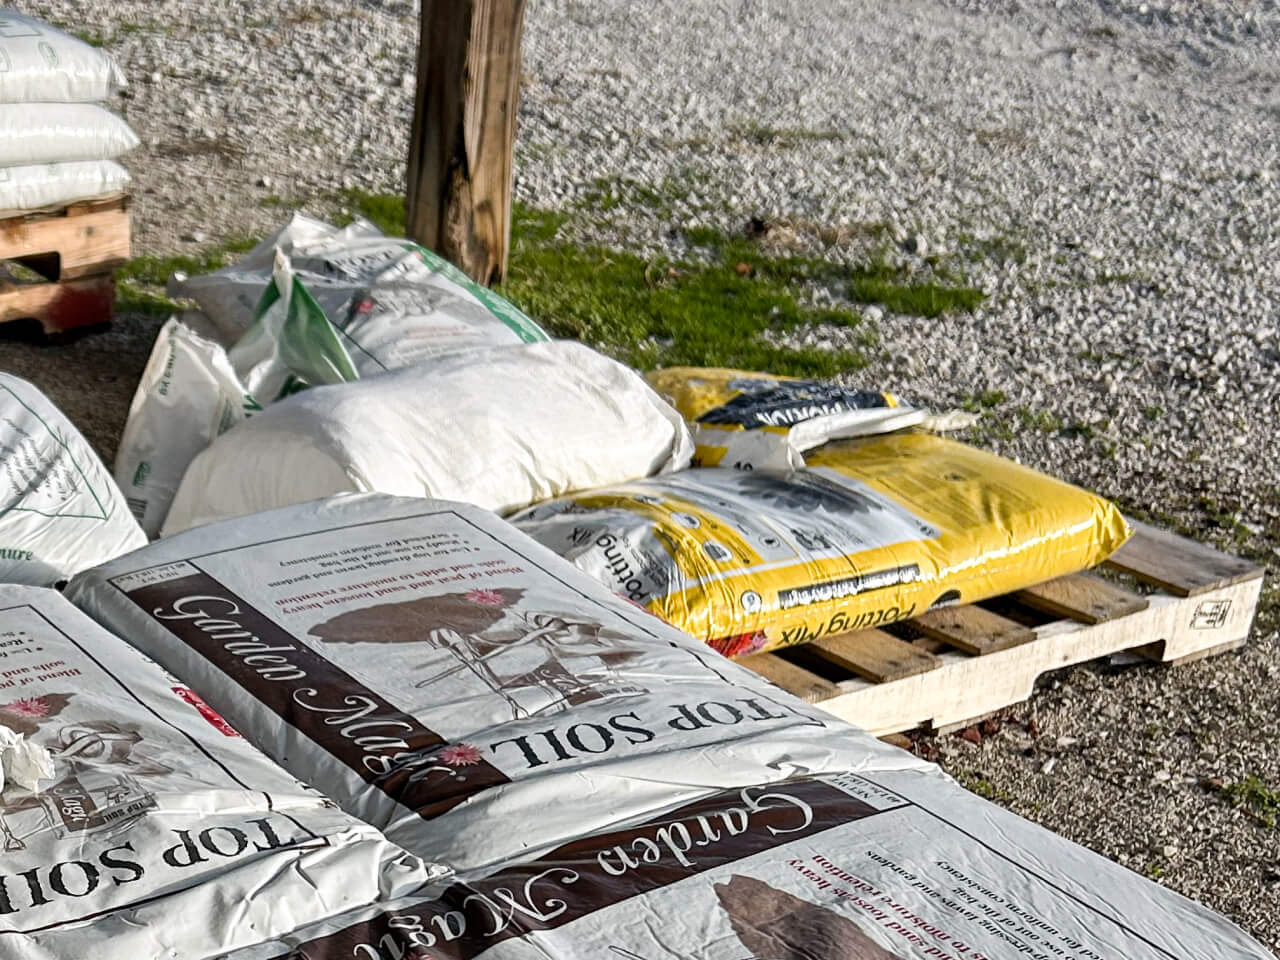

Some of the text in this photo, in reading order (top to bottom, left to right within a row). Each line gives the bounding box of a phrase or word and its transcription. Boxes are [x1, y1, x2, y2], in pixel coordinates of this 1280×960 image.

[438, 575, 465, 585] peat
[469, 571, 483, 580] of
[377, 584, 407, 598] sand
[412, 579, 435, 590] and
[323, 591, 375, 606] loosens
[282, 601, 322, 616] heavy
[153, 595, 307, 682] Garden
[20, 677, 34, 687] of
[37, 668, 83, 682] Blend
[489, 699, 788, 769] TOP SOIL
[596, 785, 817, 877] Garden
[163, 814, 298, 869] TOP
[787, 857, 833, 890] heavy
[812, 852, 879, 897] retention
